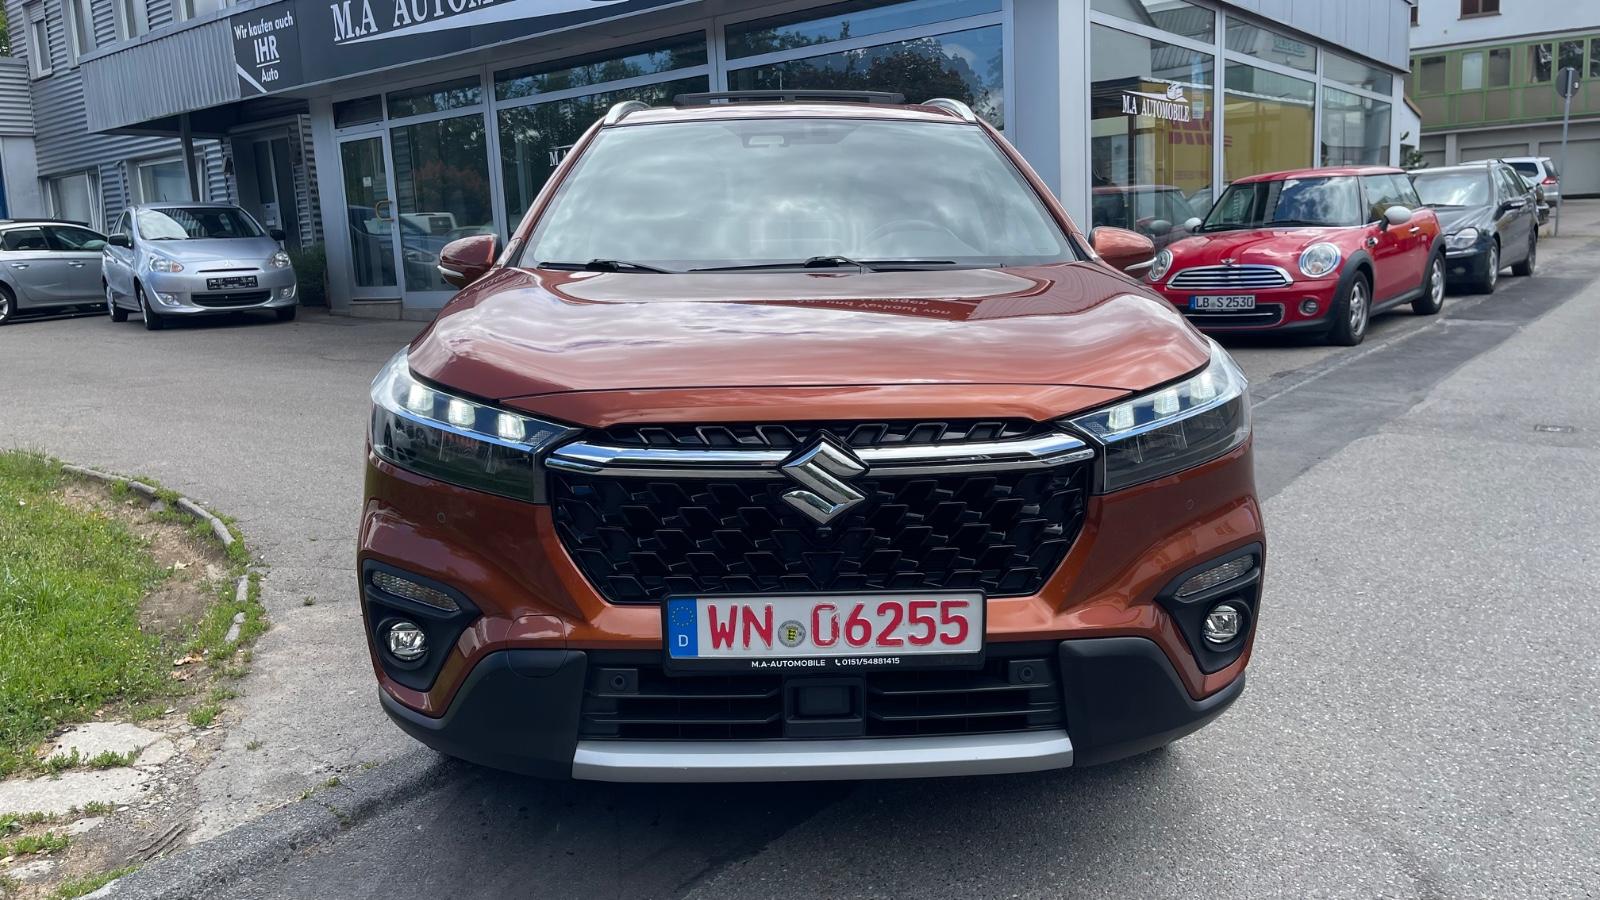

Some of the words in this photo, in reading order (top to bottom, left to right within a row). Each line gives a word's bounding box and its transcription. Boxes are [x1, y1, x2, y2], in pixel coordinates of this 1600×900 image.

[233, 24, 247, 40] Wir
[248, 18, 274, 37] kaufen
[274, 10, 294, 30] auch
[330, 0, 379, 42] M.A
[254, 35, 280, 63] IHR
[261, 68, 279, 83] Auto
[1122, 95, 1137, 115] M.A
[1141, 101, 1190, 123] AUTOMOBILE
[1196, 297, 1210, 308] LB
[1216, 297, 1224, 308] S
[1226, 296, 1254, 308] 2530
[707, 604, 774, 650] WN
[810, 599, 971, 648] 06255
[678, 634, 689, 647] D
[751, 660, 826, 668] M.A-AUTOMOBILE
[841, 657, 900, 666] 0151/54881415
